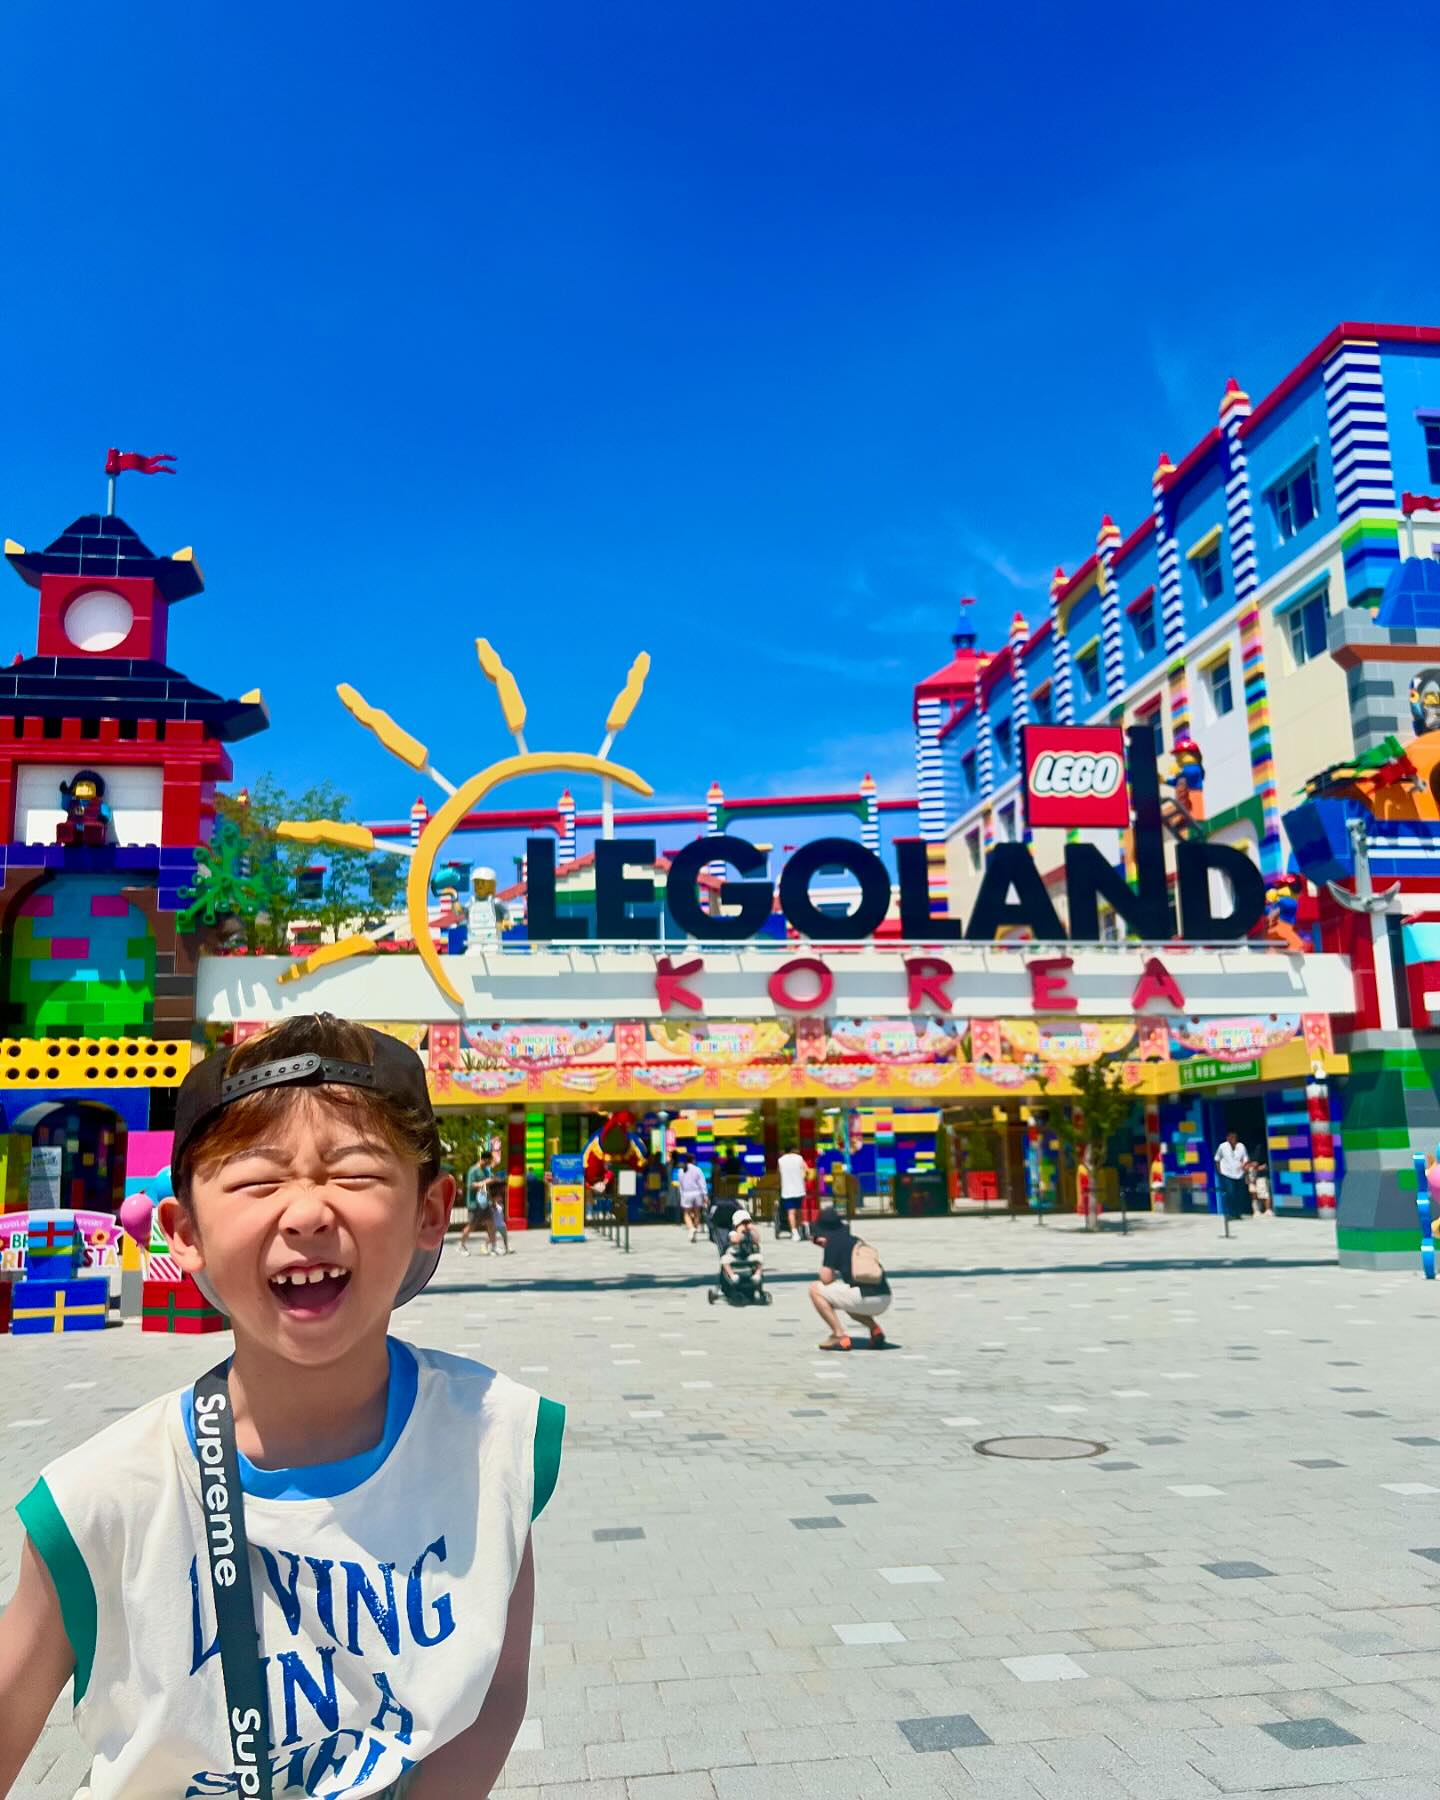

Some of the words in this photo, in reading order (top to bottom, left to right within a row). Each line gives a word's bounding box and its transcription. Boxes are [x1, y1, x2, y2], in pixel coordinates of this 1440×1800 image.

[1033, 754, 1120, 795] LEGO
[655, 956, 1185, 1012] KOREA
[82, 1247, 117, 1268] STA
[194, 1393, 237, 1588] Supreme
[189, 1534, 456, 1676] LVING
[371, 1672, 413, 1745] A
[231, 1707, 261, 1800] Sup
